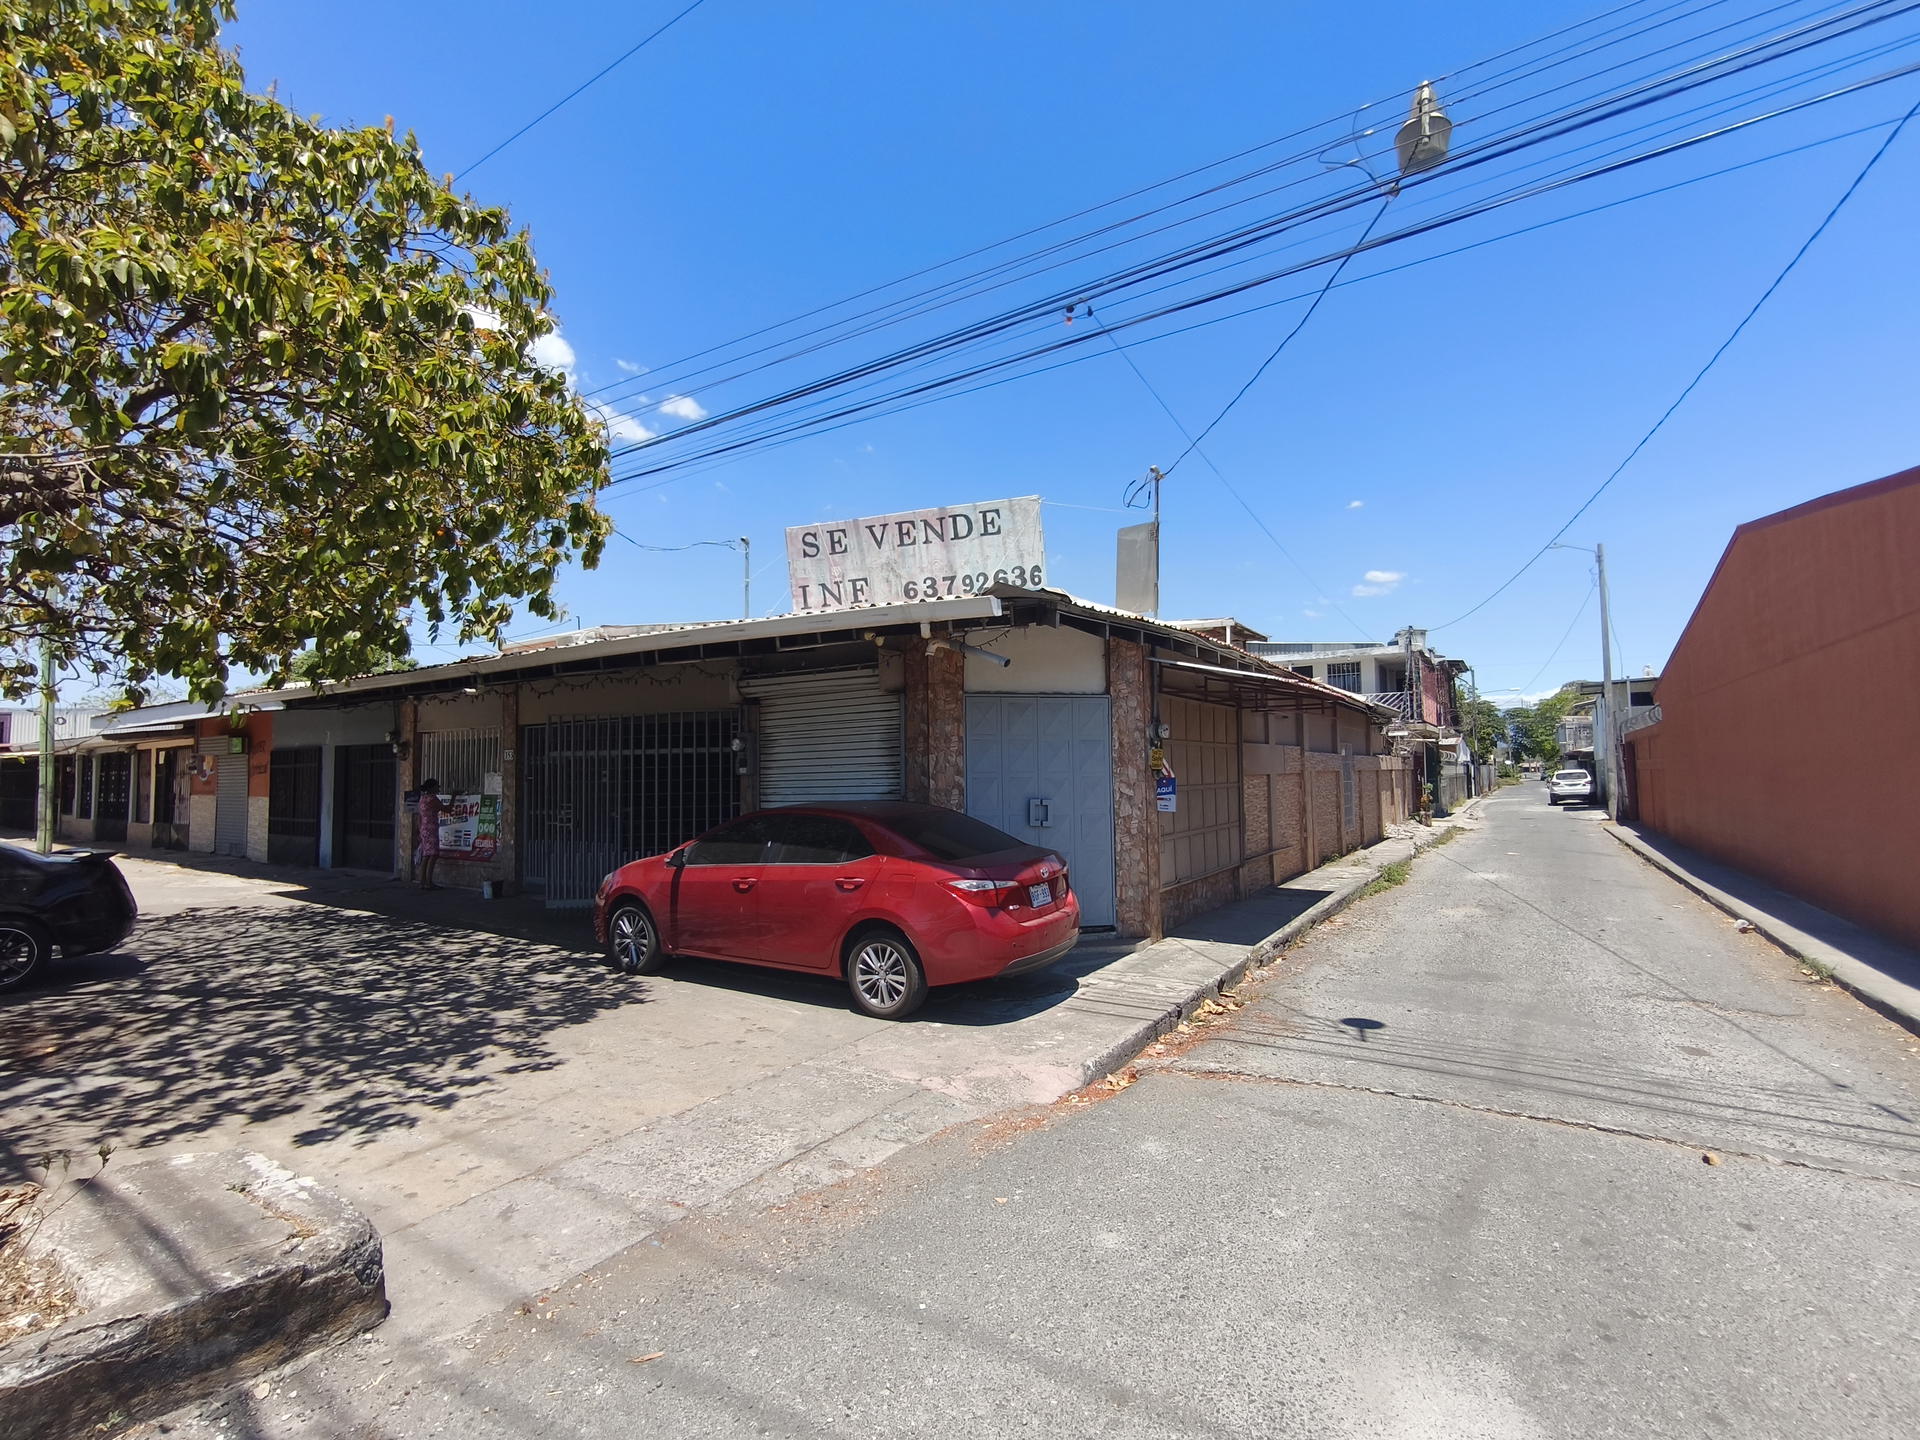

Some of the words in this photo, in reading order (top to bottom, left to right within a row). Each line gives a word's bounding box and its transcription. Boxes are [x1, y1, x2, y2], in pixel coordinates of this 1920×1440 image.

[802, 528, 848, 558] SE
[865, 509, 1001, 549] VENDE
[903, 565, 1043, 599] 63792636
